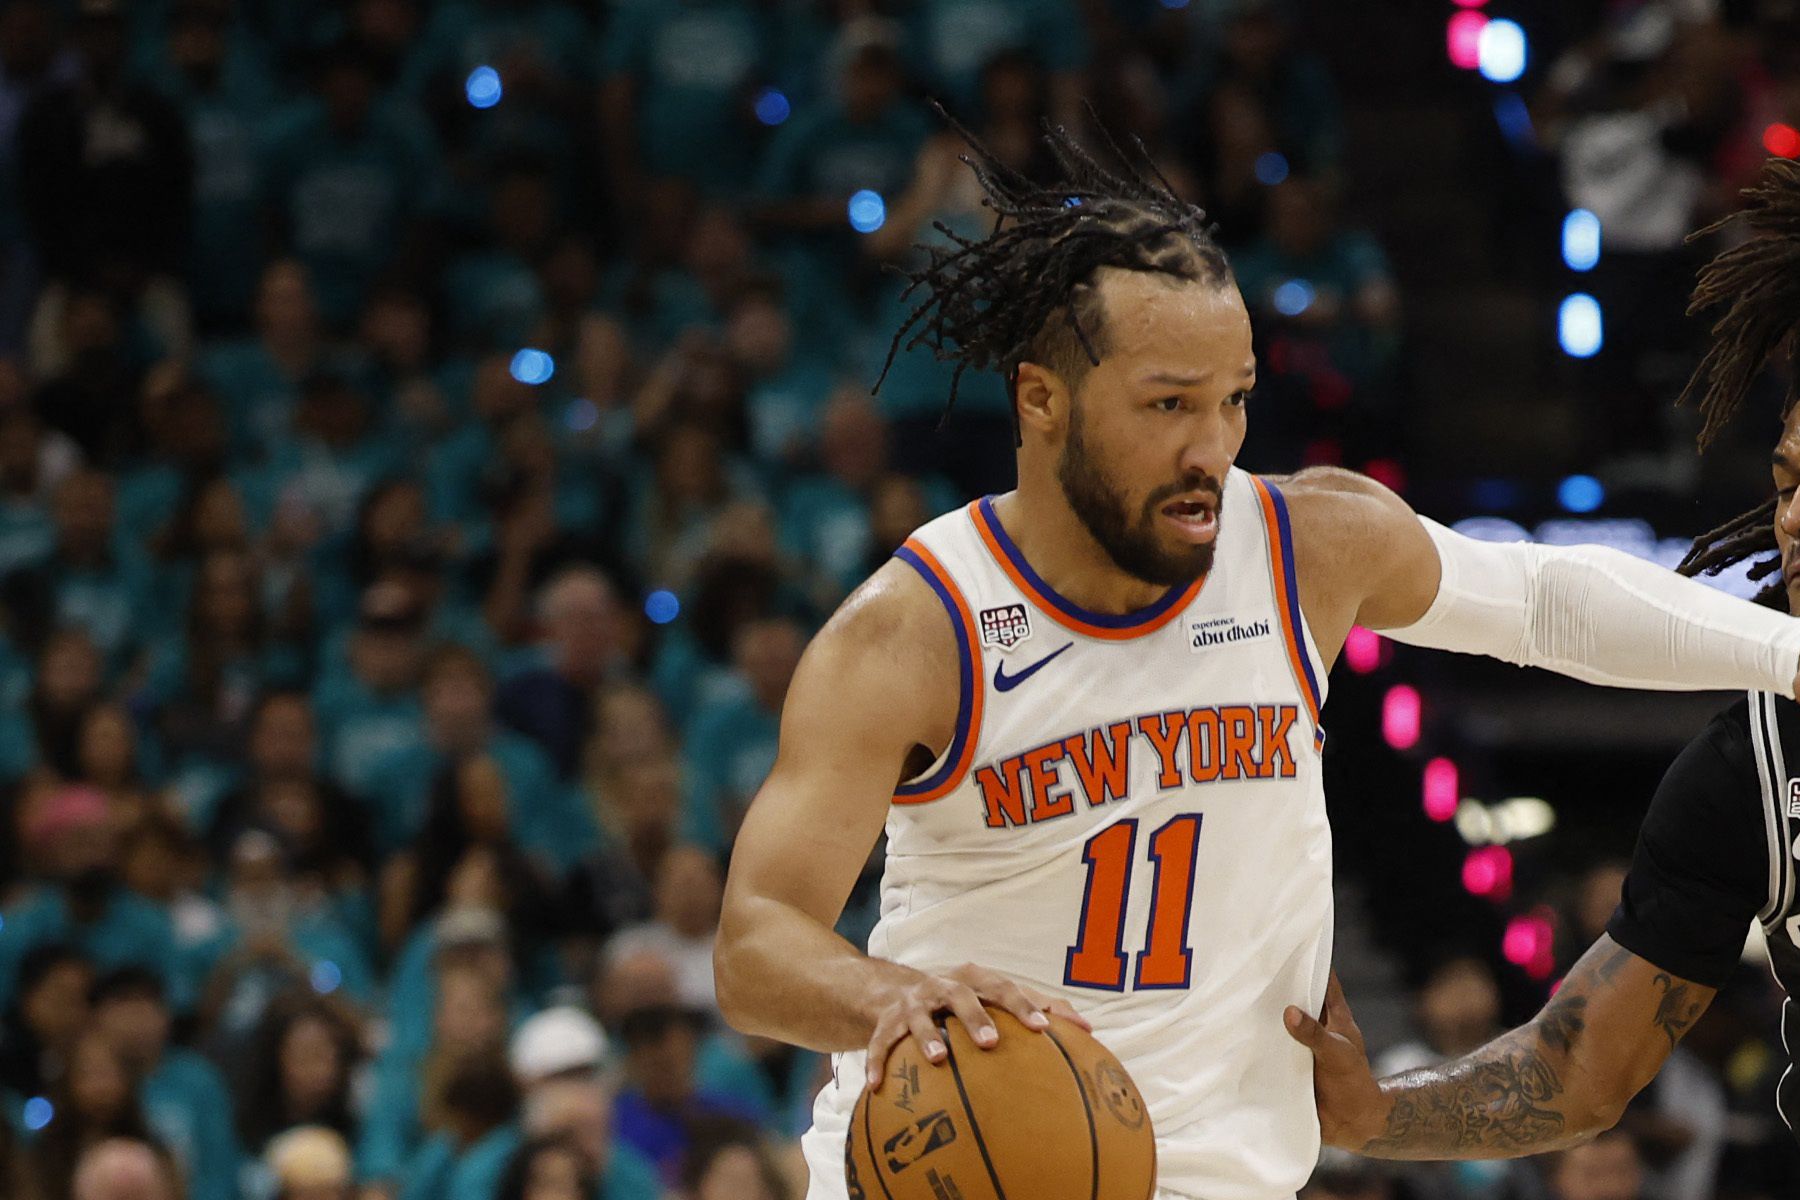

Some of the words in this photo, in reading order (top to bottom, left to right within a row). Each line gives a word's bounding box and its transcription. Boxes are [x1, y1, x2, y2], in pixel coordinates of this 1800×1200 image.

[984, 607, 1023, 622] USA
[1192, 616, 1235, 630] experience
[985, 625, 1029, 641] 250
[1192, 625, 1225, 647] abu
[1226, 618, 1270, 641] dhabi
[973, 720, 1132, 828] NEW
[1138, 705, 1299, 790] YORK
[1063, 812, 1203, 993] 11
